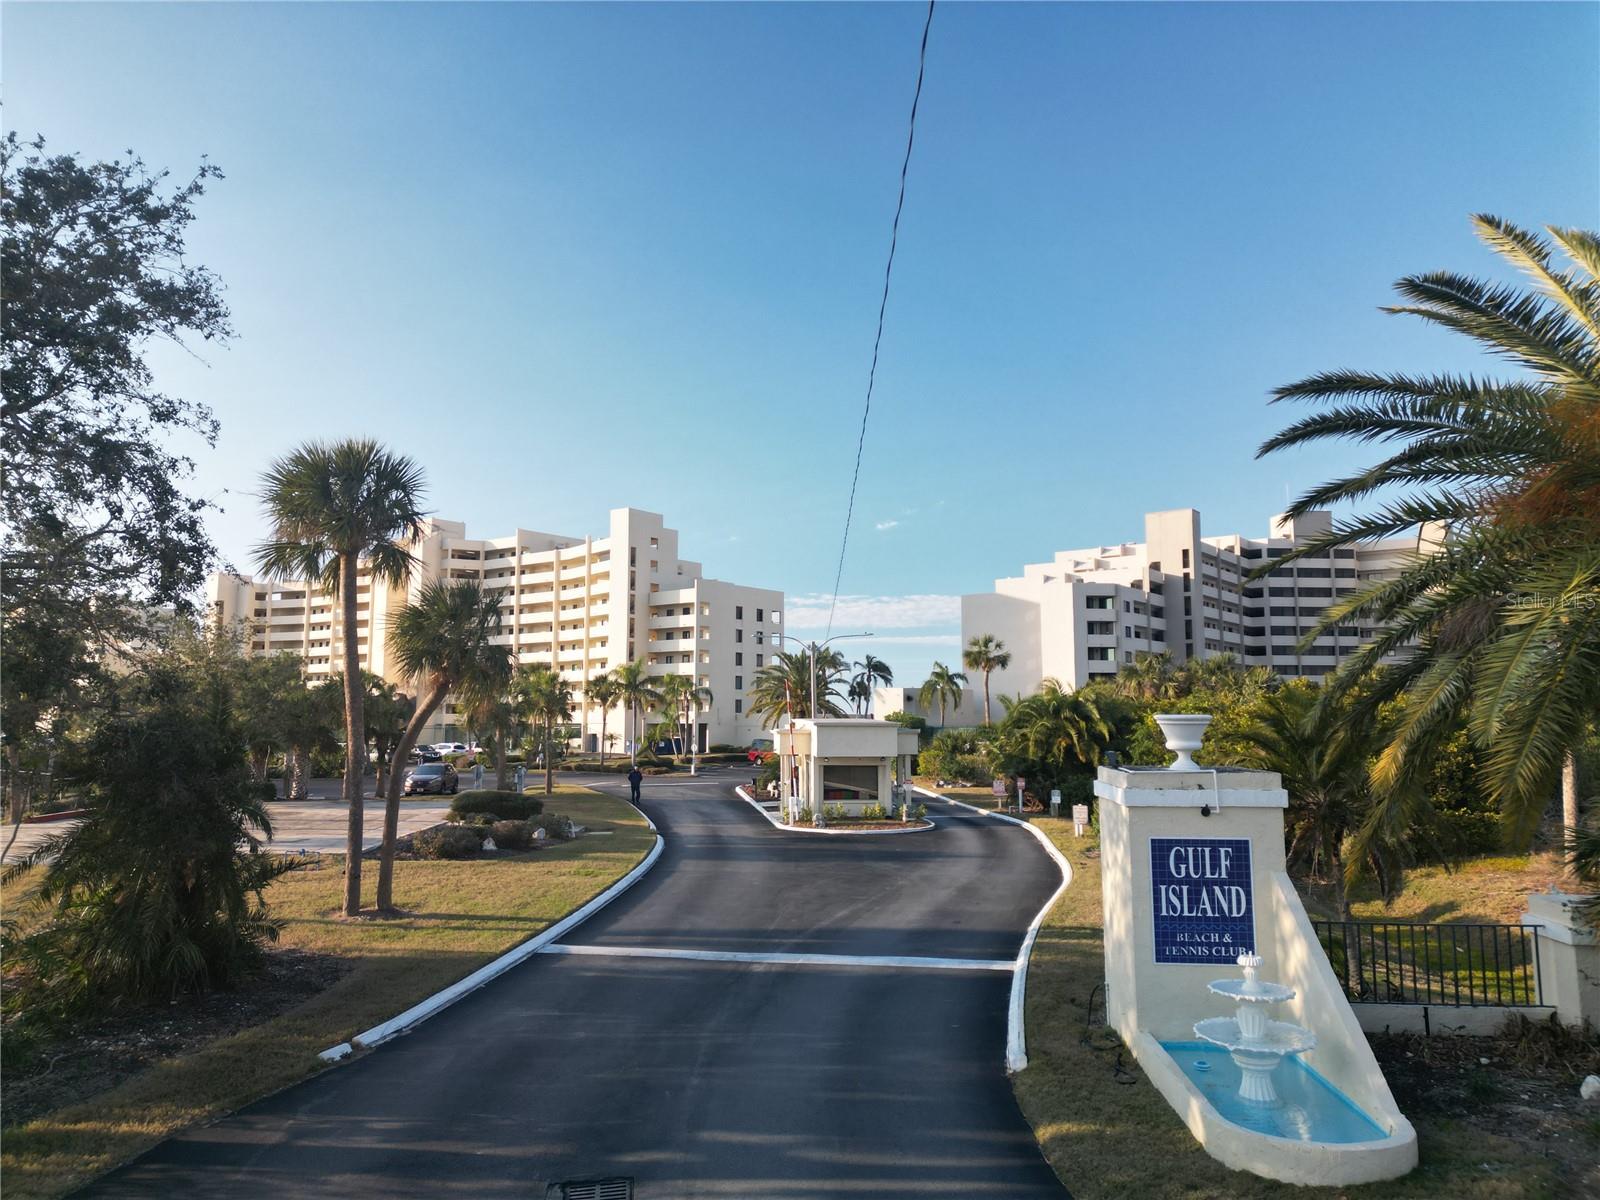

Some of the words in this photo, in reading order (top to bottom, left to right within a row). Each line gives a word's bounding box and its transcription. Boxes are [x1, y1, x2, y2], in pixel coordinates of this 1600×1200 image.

[1169, 846, 1233, 879] GULF
[1159, 884, 1247, 918] ISLAND
[1176, 932, 1220, 943] BEACH
[1223, 932, 1233, 943] &
[1165, 945, 1210, 956] TENNIS
[1212, 946, 1247, 957] CLUB
